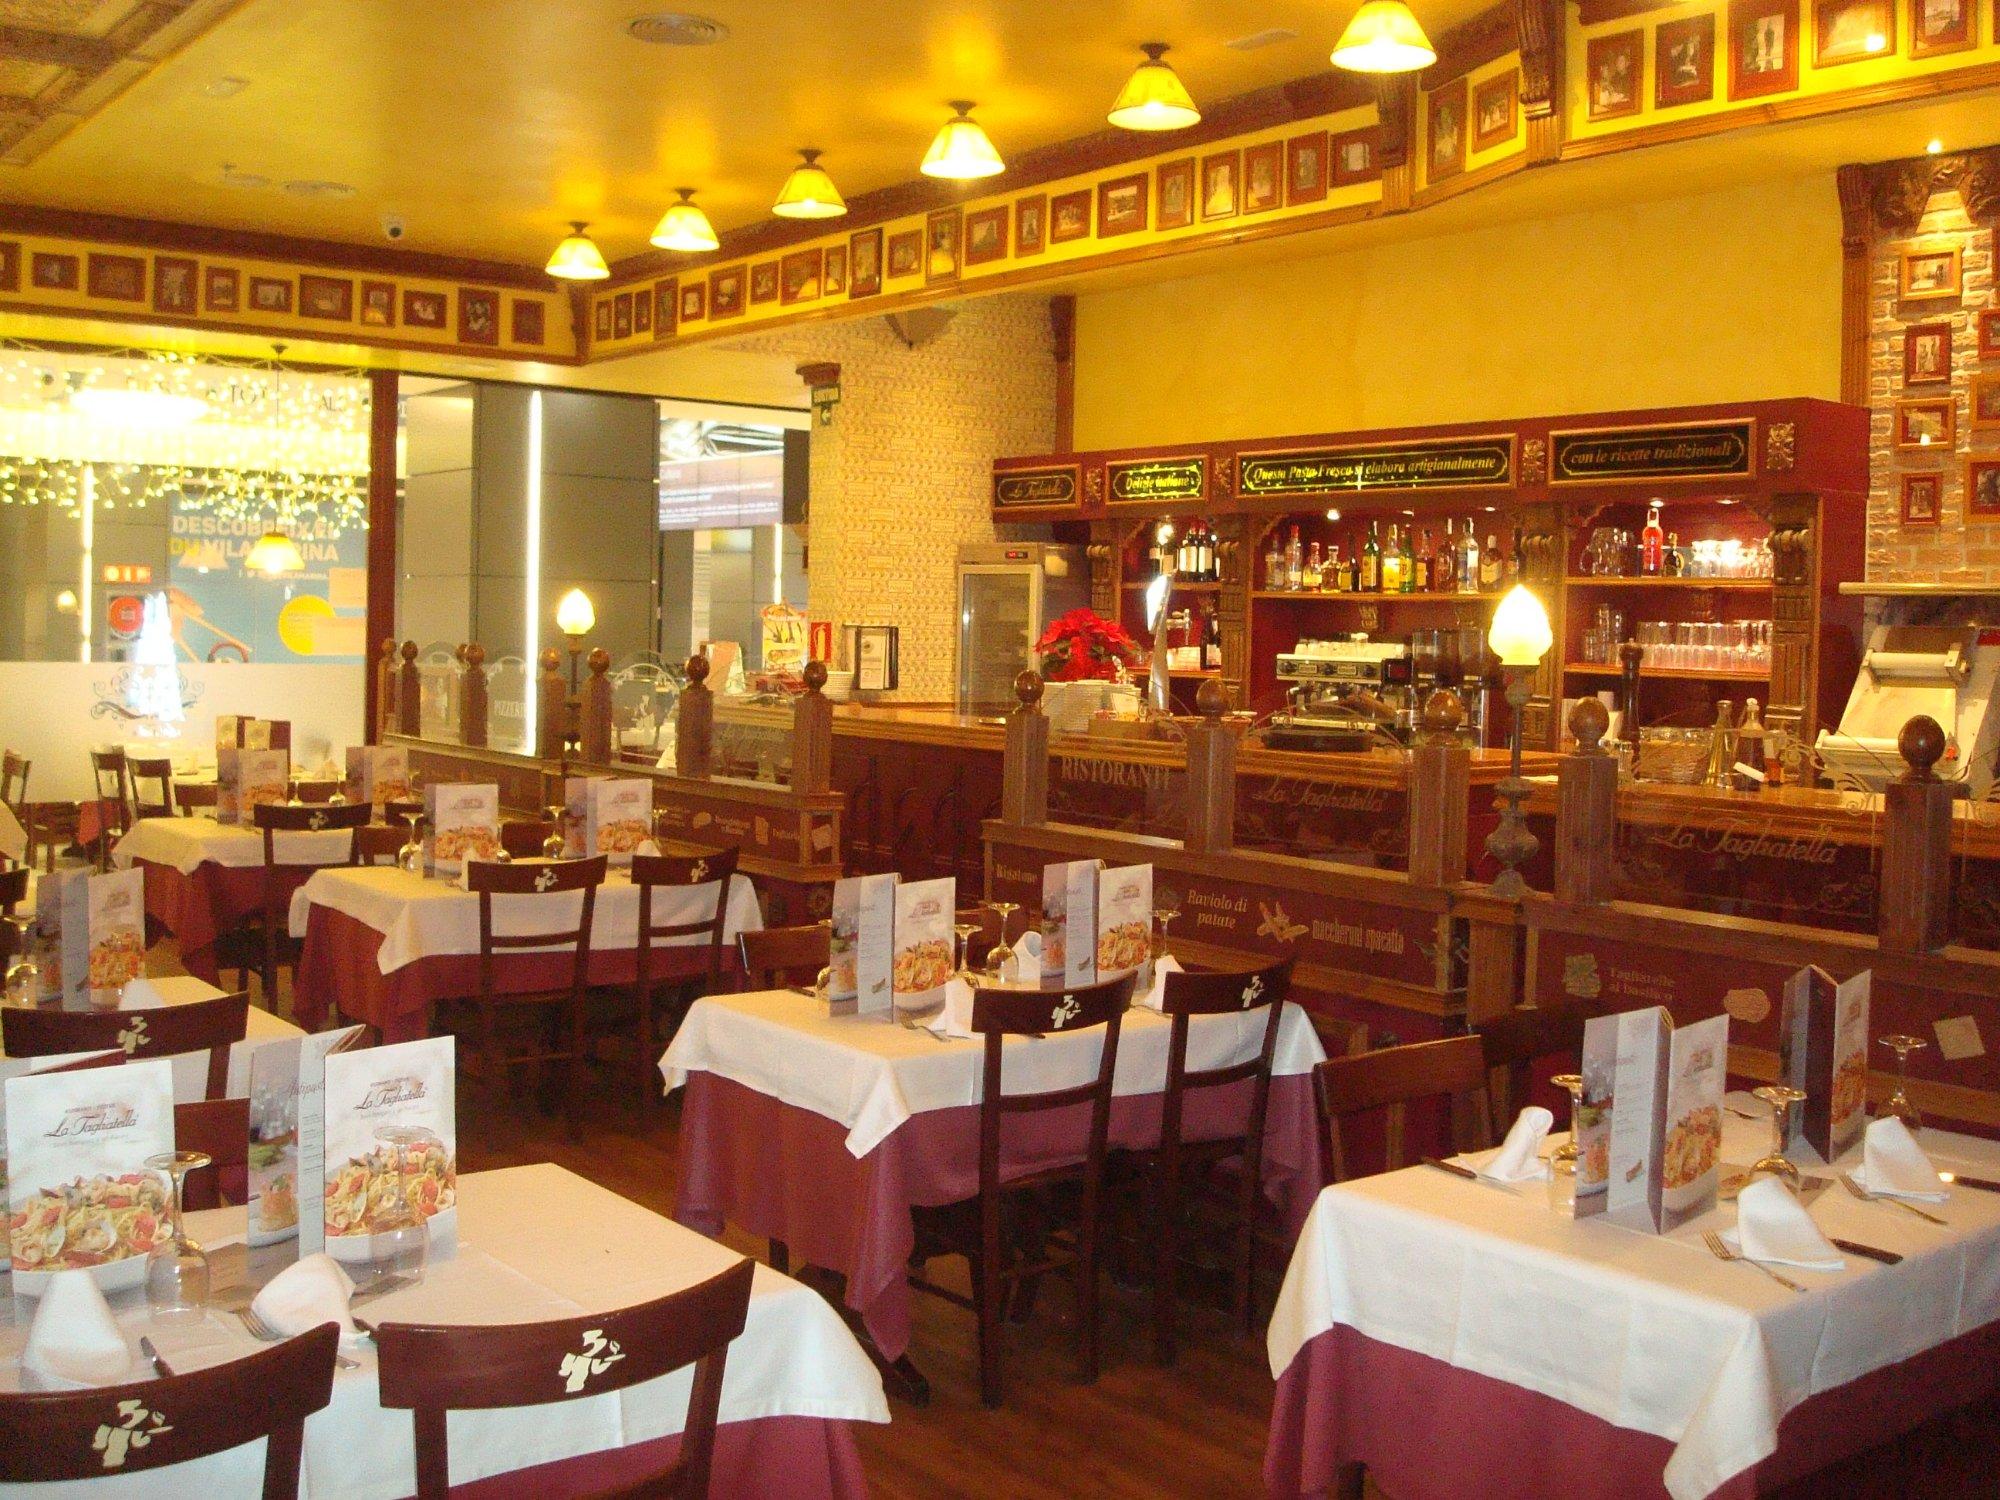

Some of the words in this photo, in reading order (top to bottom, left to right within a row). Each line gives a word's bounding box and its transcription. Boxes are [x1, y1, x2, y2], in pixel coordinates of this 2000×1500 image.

[1571, 452, 1593, 464] con
[1187, 889, 1232, 910] Raviolo
[1234, 898, 1248, 912] di
